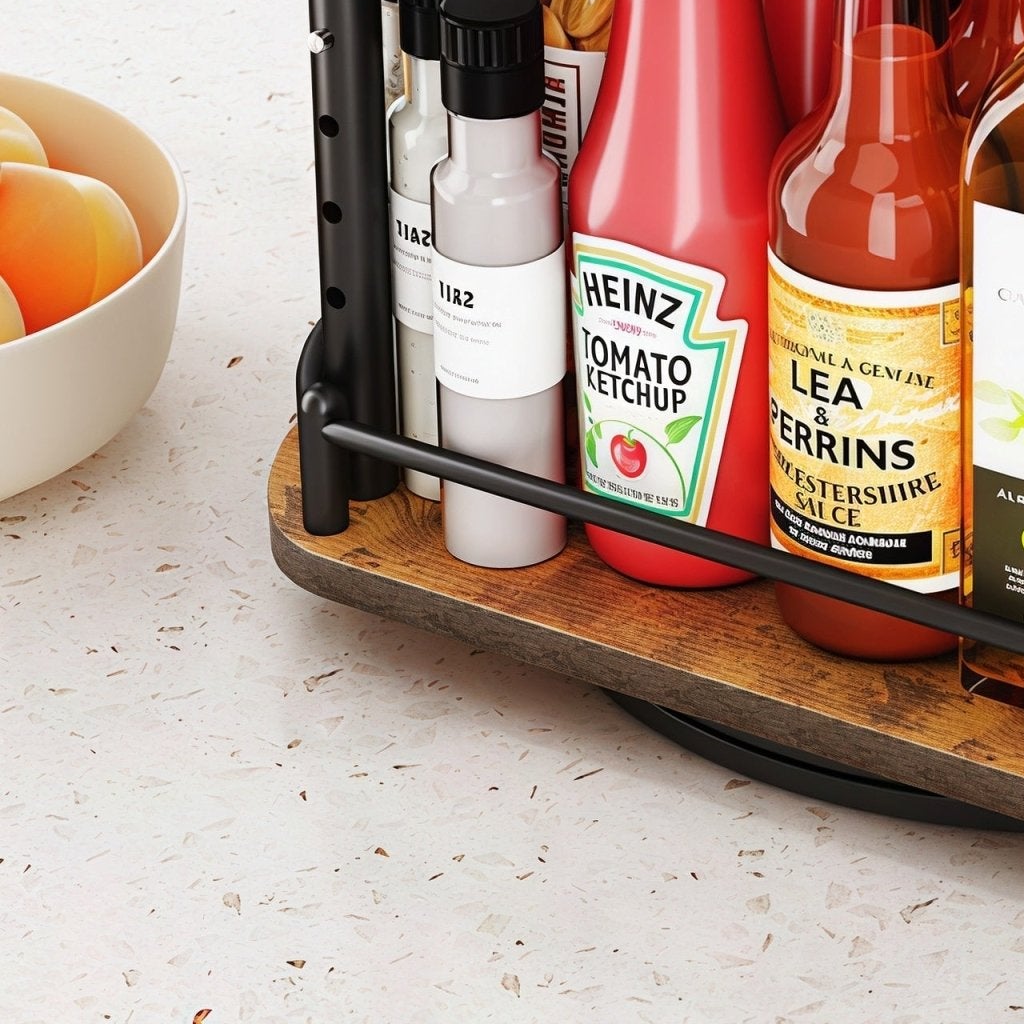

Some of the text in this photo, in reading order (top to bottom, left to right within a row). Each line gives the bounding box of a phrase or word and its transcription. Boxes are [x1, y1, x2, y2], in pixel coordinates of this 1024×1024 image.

[582, 271, 684, 330] HEINZ
[581, 326, 693, 387] TOMATO
[586, 363, 687, 414] KETCHUP
[790, 358, 864, 410] LEA
[813, 406, 830, 427] &
